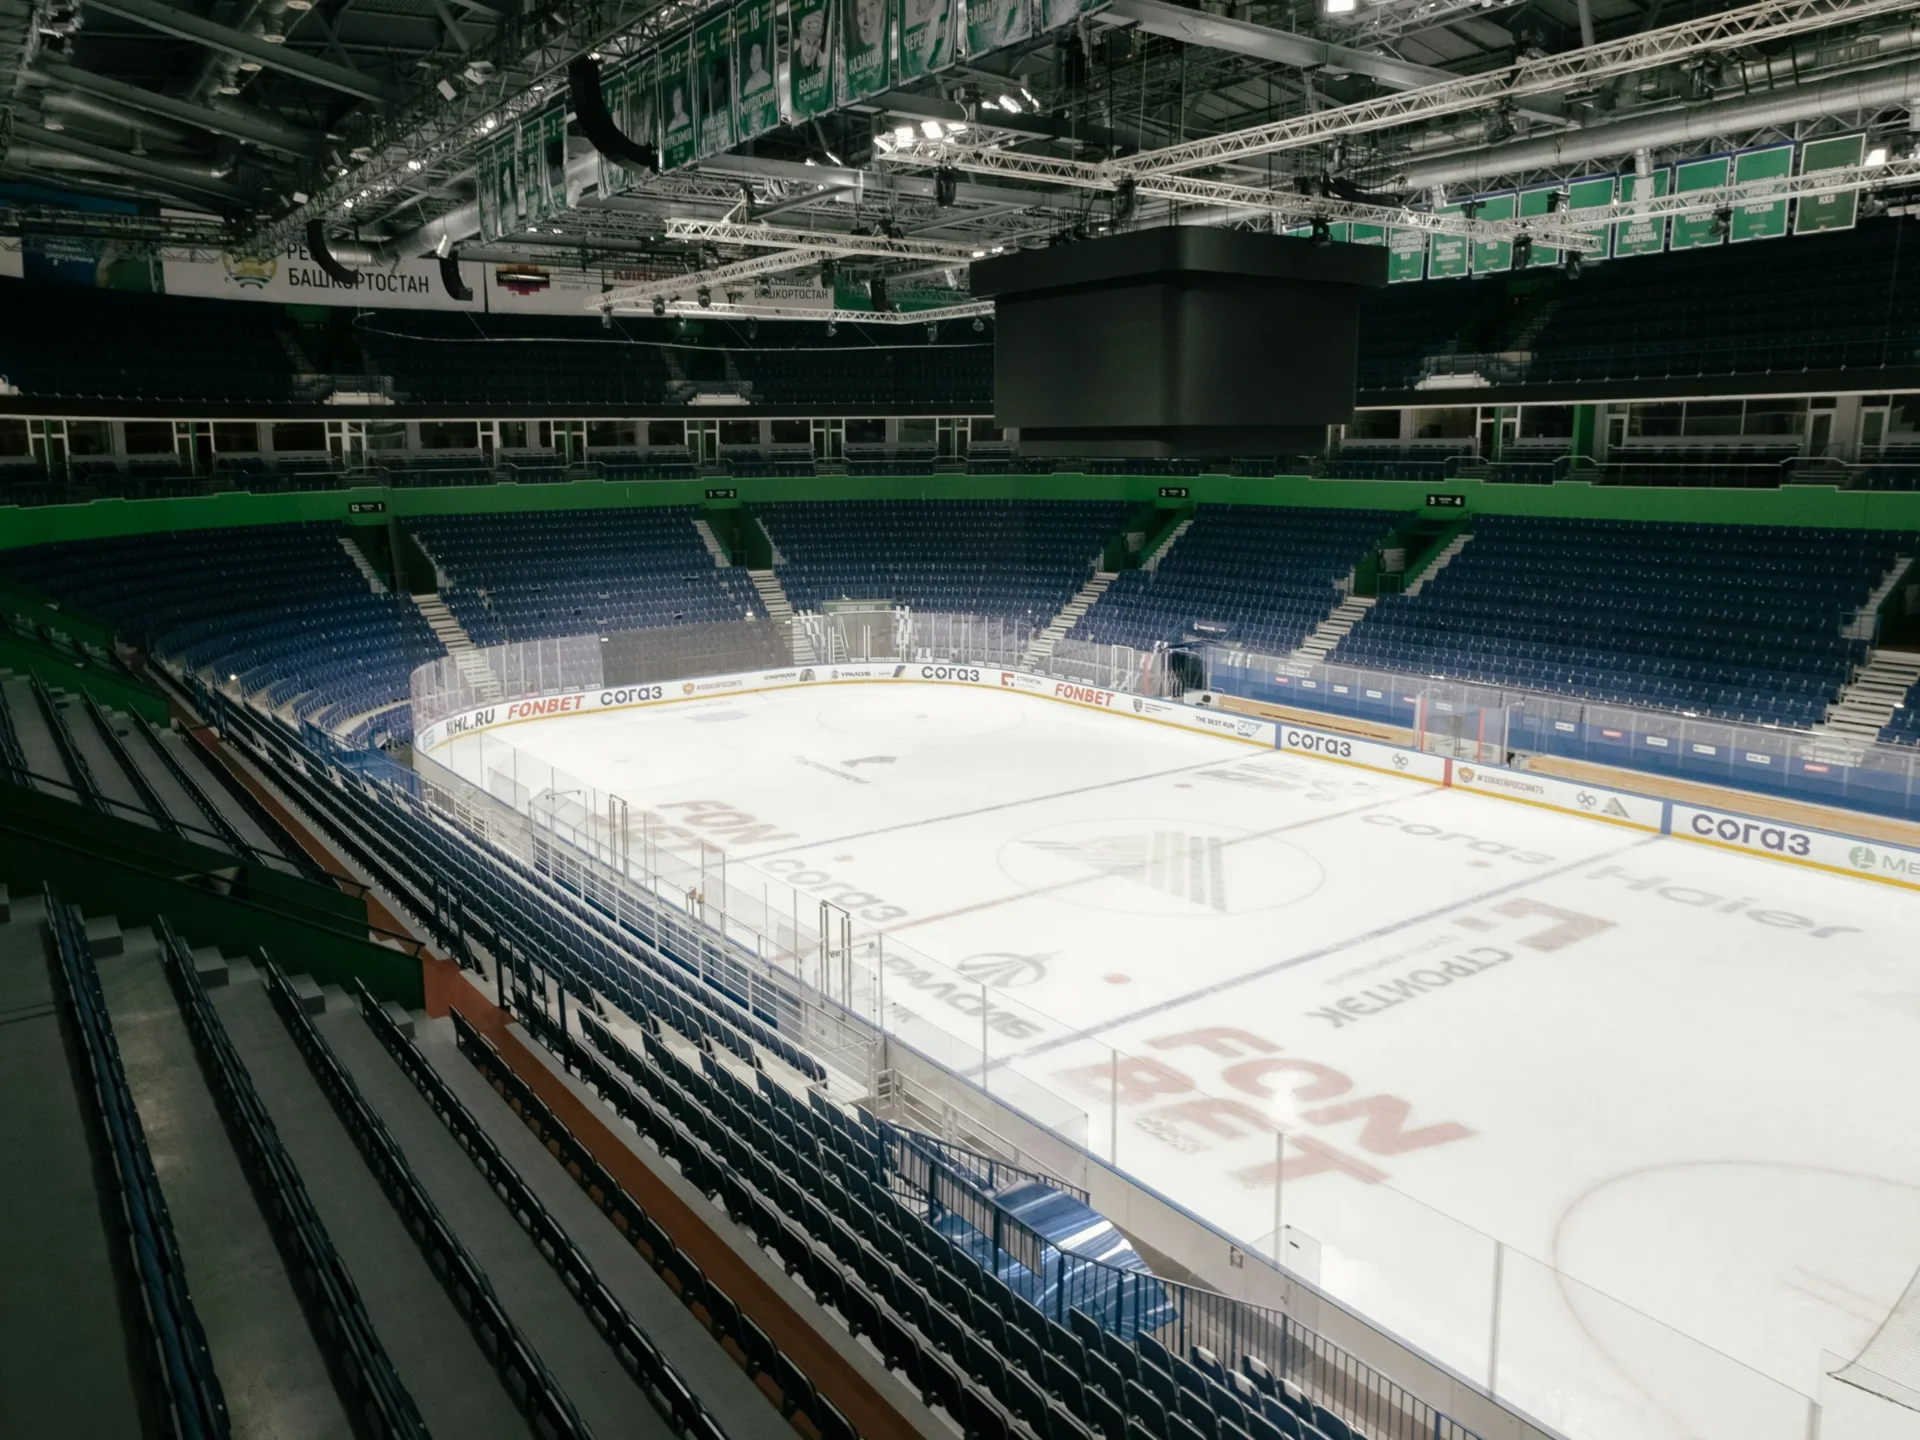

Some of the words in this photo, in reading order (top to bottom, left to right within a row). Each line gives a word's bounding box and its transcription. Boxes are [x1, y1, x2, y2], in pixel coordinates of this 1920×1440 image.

[749, 6, 760, 32] 18
[669, 51, 682, 76] 22
[798, 72, 824, 96] БЫКОВ
[1744, 202, 1775, 215] РОССИИ
[1818, 194, 1836, 205] КХЛ
[1622, 231, 1658, 244] ГАГАРИНА
[1628, 222, 1653, 235] КУБОК
[288, 267, 430, 294] БАШРТОСТАН
[728, 490, 735, 498] 2
[1160, 488, 1167, 497] 2
[1180, 488, 1187, 497] 3
[1429, 496, 1436, 505] 3
[1454, 496, 1462, 506] 4
[351, 503, 360, 512] 12
[507, 694, 586, 721] FONBET
[1054, 683, 1115, 708] FONBET
[446, 708, 496, 737] KHL.RU
[1195, 715, 1206, 724] THE
[1207, 718, 1222, 727] BEST
[1222, 721, 1235, 730] RUN
[1237, 722, 1257, 736] SAP
[654, 799, 801, 845] FON
[1583, 864, 1865, 939] Haier
[1141, 1024, 1480, 1158] FON
[1052, 1055, 1394, 1187] BET
